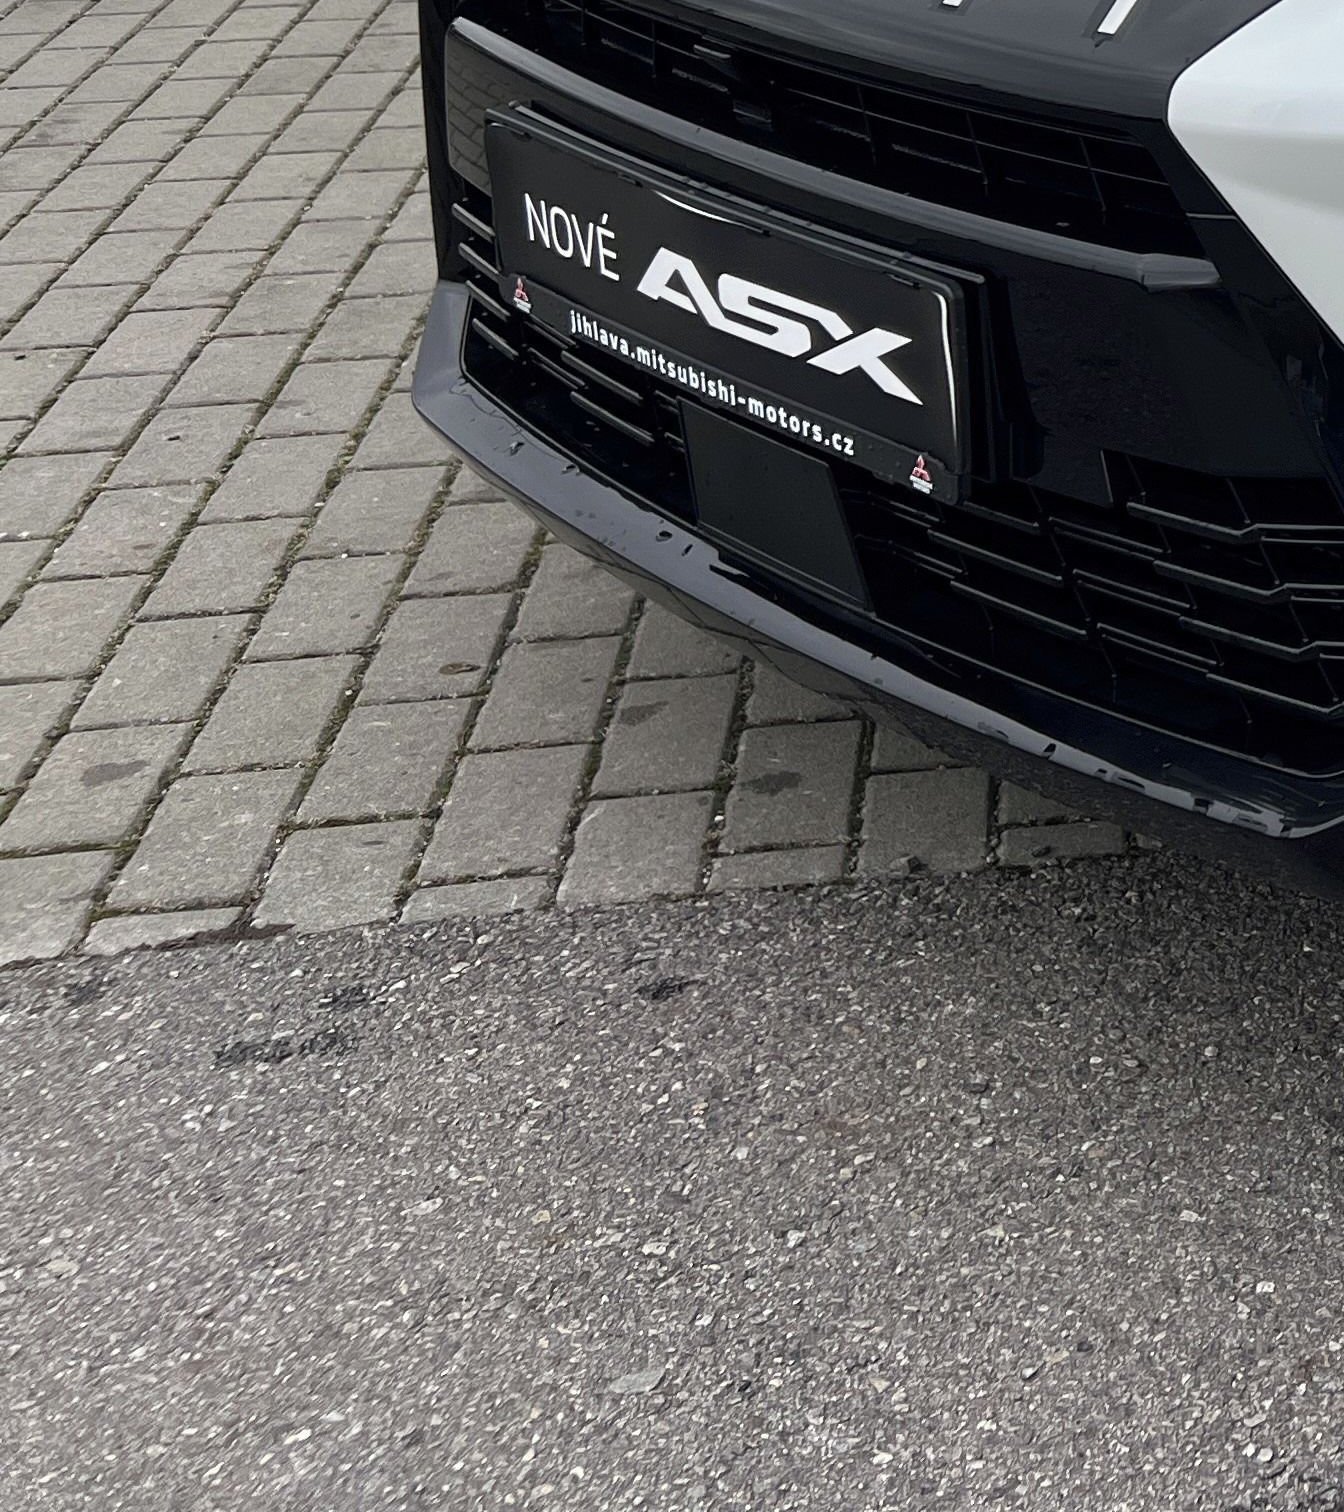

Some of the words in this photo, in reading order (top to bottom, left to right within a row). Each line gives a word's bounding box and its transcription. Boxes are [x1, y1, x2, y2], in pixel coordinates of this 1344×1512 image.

[524, 193, 620, 282] NOVÉ
[570, 309, 855, 457] jihlava.mitsubishi-motors.cz
[636, 246, 924, 406] ASX
